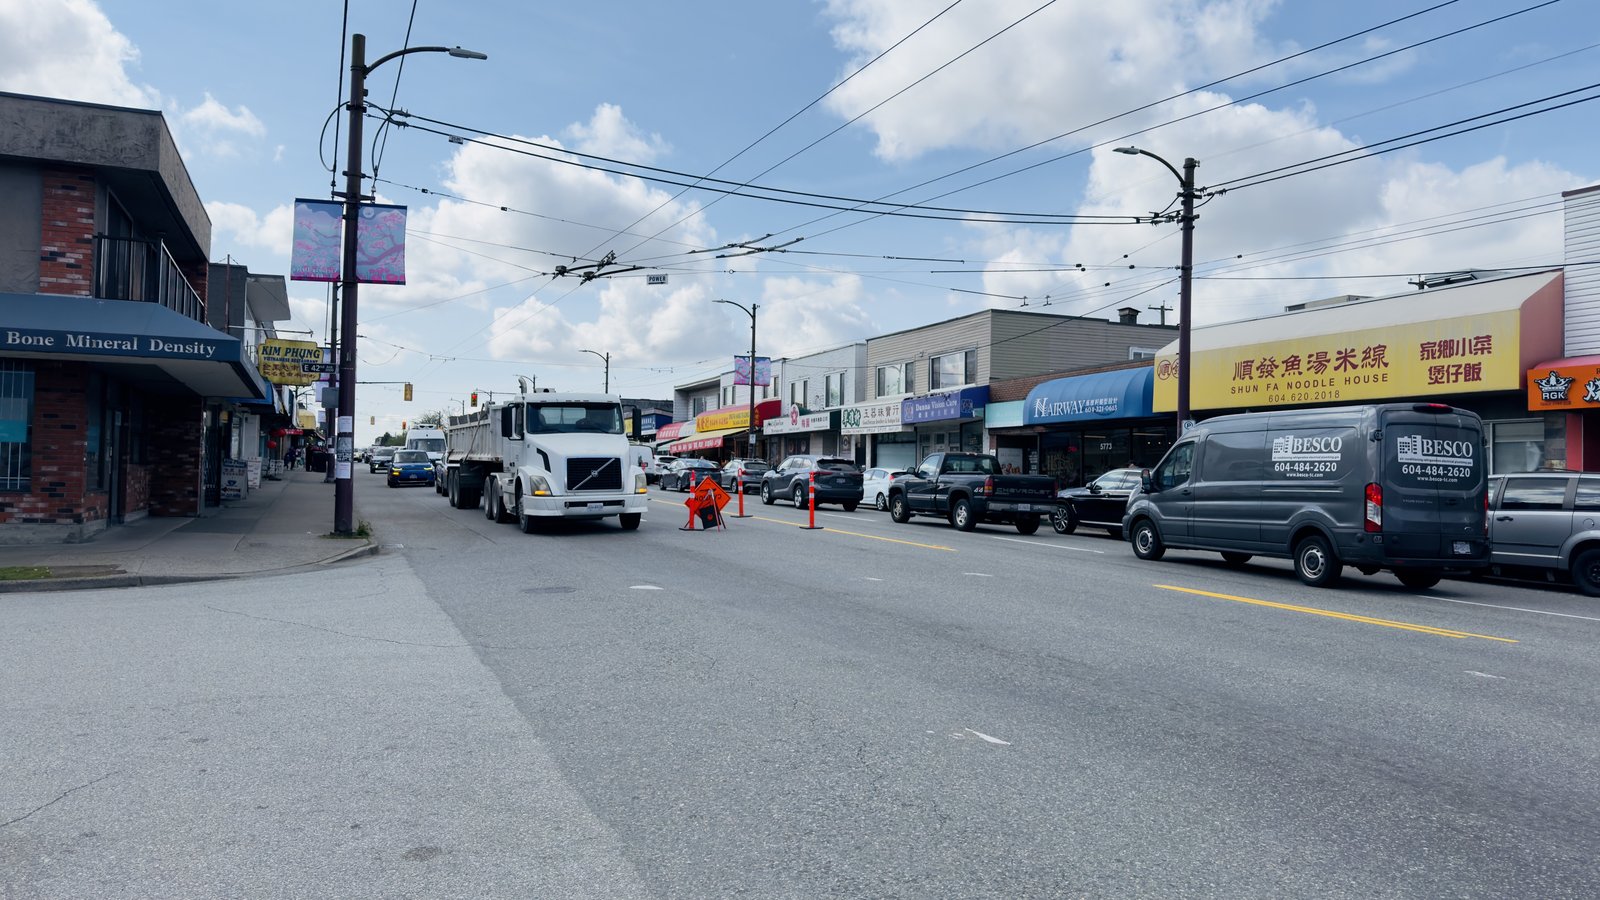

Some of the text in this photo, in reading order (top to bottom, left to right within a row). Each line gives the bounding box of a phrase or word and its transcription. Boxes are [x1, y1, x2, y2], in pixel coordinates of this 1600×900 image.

[6, 330, 216, 357] Bone Mineral Density
[261, 345, 281, 356] KIM
[1420, 335, 1493, 361] 家鄉小菜
[1232, 344, 1390, 382] 順發魚湯米線
[1428, 362, 1482, 385] 煲仔飯
[1231, 373, 1389, 394] SHUN FA NOODLE HOUSE
[1268, 390, 1341, 403] 604.620.2018
[1542, 391, 1565, 400] RGK
[931, 401, 945, 409] Vision
[1292, 436, 1343, 453] BESCO
[1422, 439, 1473, 458] BESCO
[1274, 462, 1337, 472] 604-484-2620
[1402, 464, 1471, 478] 604-484-2620
